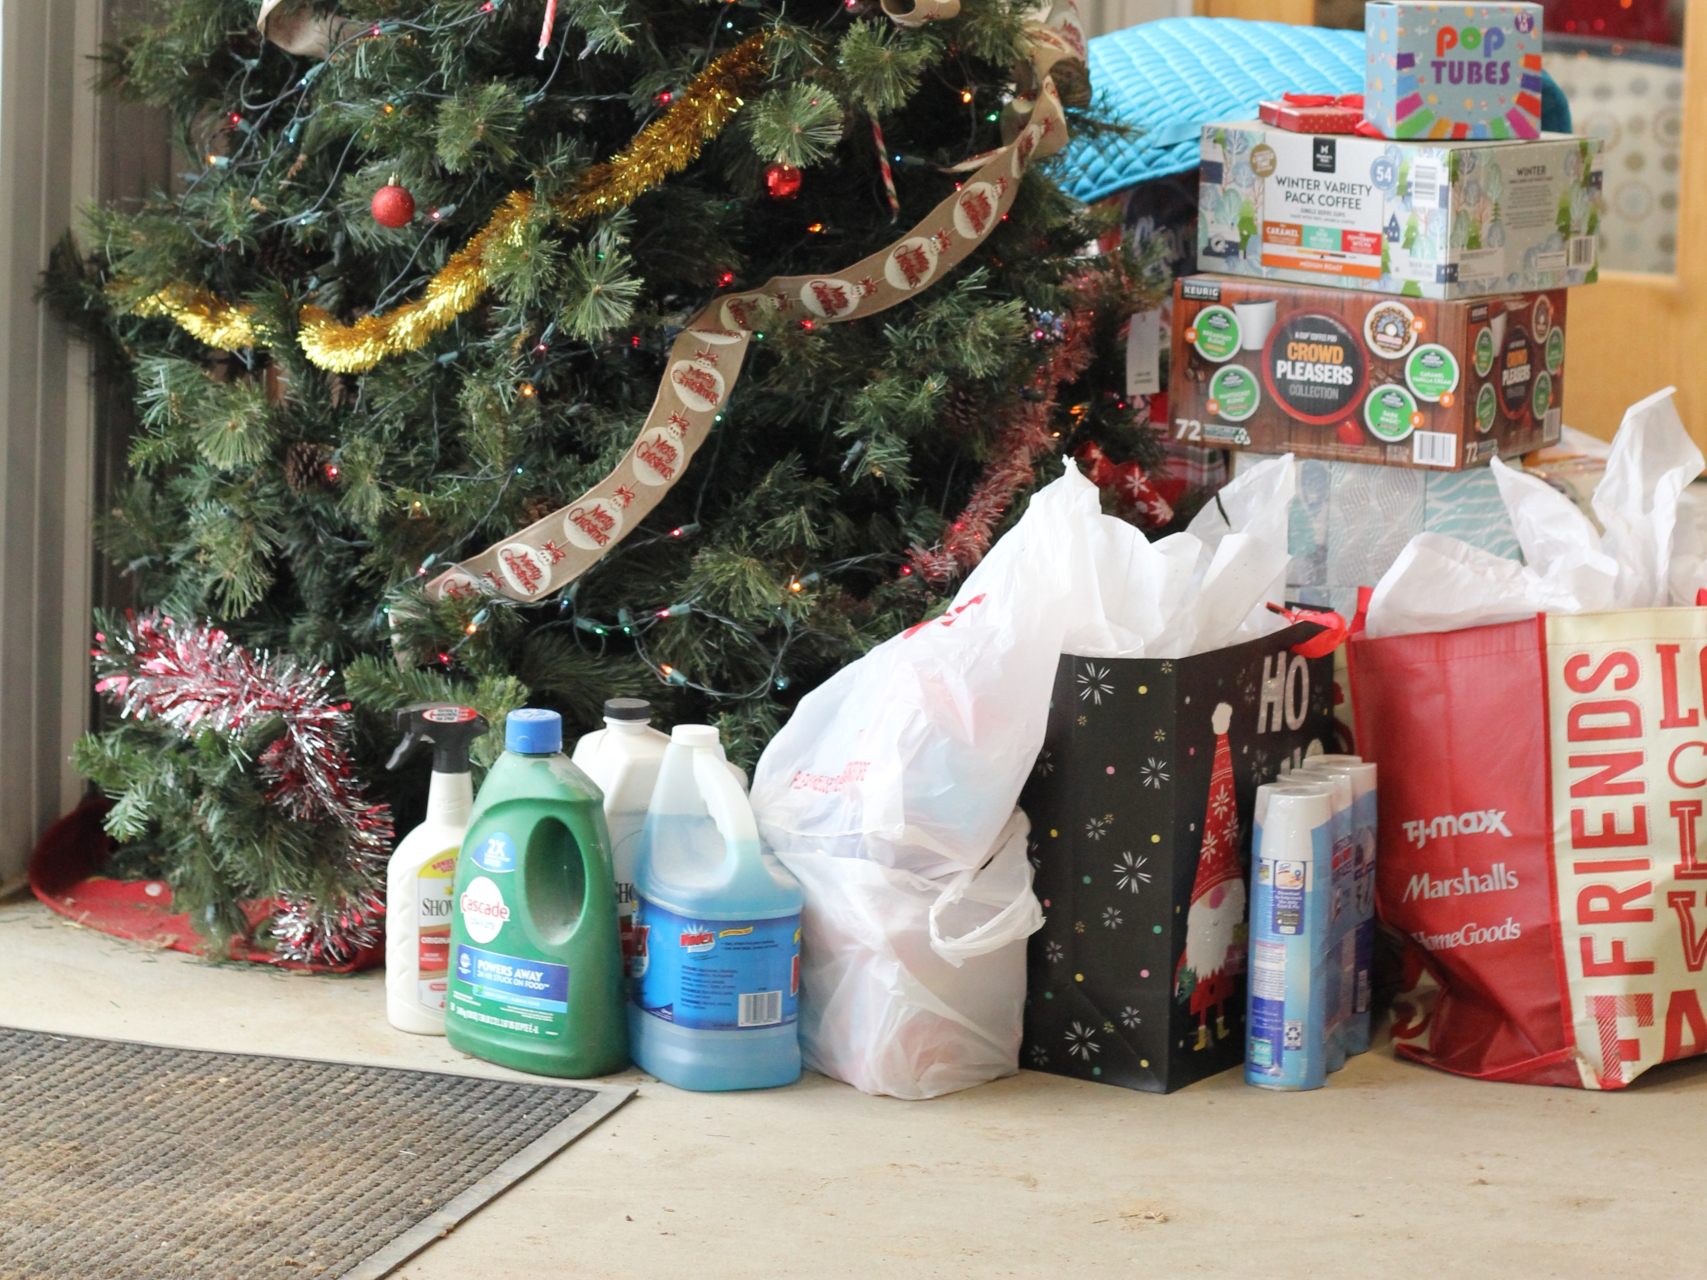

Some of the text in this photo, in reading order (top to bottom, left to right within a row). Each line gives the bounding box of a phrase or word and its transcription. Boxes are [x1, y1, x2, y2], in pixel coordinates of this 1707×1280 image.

[1430, 60, 1511, 85] TUBES
[1376, 167, 1392, 183] 54
[1516, 165, 1547, 177] WINTER
[1275, 175, 1373, 197] WINTER VARIETY
[1285, 191, 1362, 210] PACK COFFEE
[1266, 226, 1299, 237] CARAMEL
[1324, 263, 1343, 272] ROAST
[1183, 285, 1219, 297] KEURIG
[1202, 330, 1233, 342] BREAKFAST
[1207, 337, 1225, 346] BLEND
[1287, 341, 1345, 365] CROWD
[1276, 360, 1354, 386] PLEASERS
[1419, 371, 1445, 379] CARAMEL
[1502, 364, 1531, 387] PLEASERS
[1288, 384, 1340, 400] COLLECTION
[1175, 418, 1202, 441] 72
[653, 433, 678, 464] Merry
[1465, 441, 1478, 464] 72
[635, 441, 674, 481] Christmas
[568, 506, 609, 548] Christmas
[587, 503, 616, 531] Merry
[498, 547, 539, 595] Christmas
[518, 550, 542, 582] Merry
[1257, 650, 1309, 734] HO
[1563, 649, 1656, 978] FRIENDS
[486, 838, 506, 857] 2X
[1401, 862, 1520, 904] Marshalls
[460, 893, 509, 920] Cascade
[469, 917, 496, 931] COMPLETE
[477, 959, 544, 983] POWERS AWAY
[484, 972, 493, 980] HR
[493, 974, 513, 985] STUCK
[513, 978, 524, 987] ON
